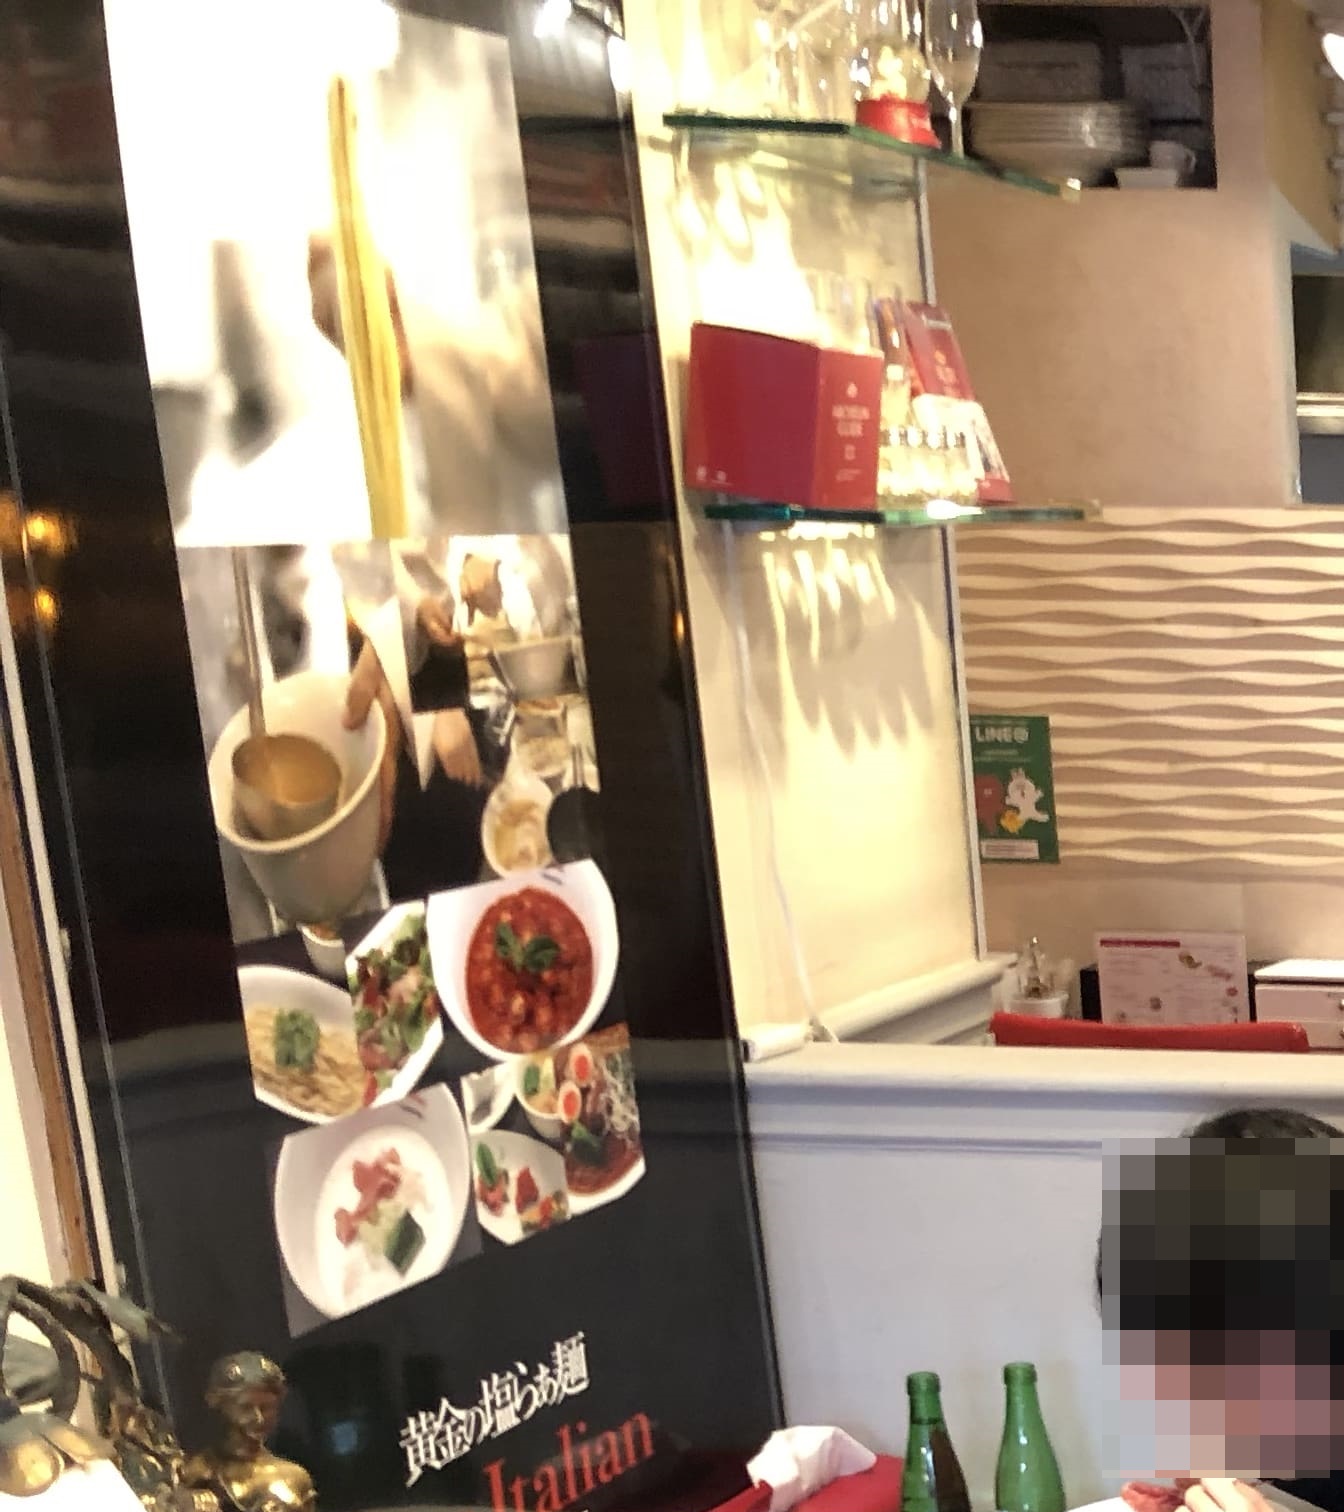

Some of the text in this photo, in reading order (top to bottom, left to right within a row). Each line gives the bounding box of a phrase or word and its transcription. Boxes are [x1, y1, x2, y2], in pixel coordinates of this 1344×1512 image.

[399, 1331, 590, 1488] 黄金の塩らぁ麺
